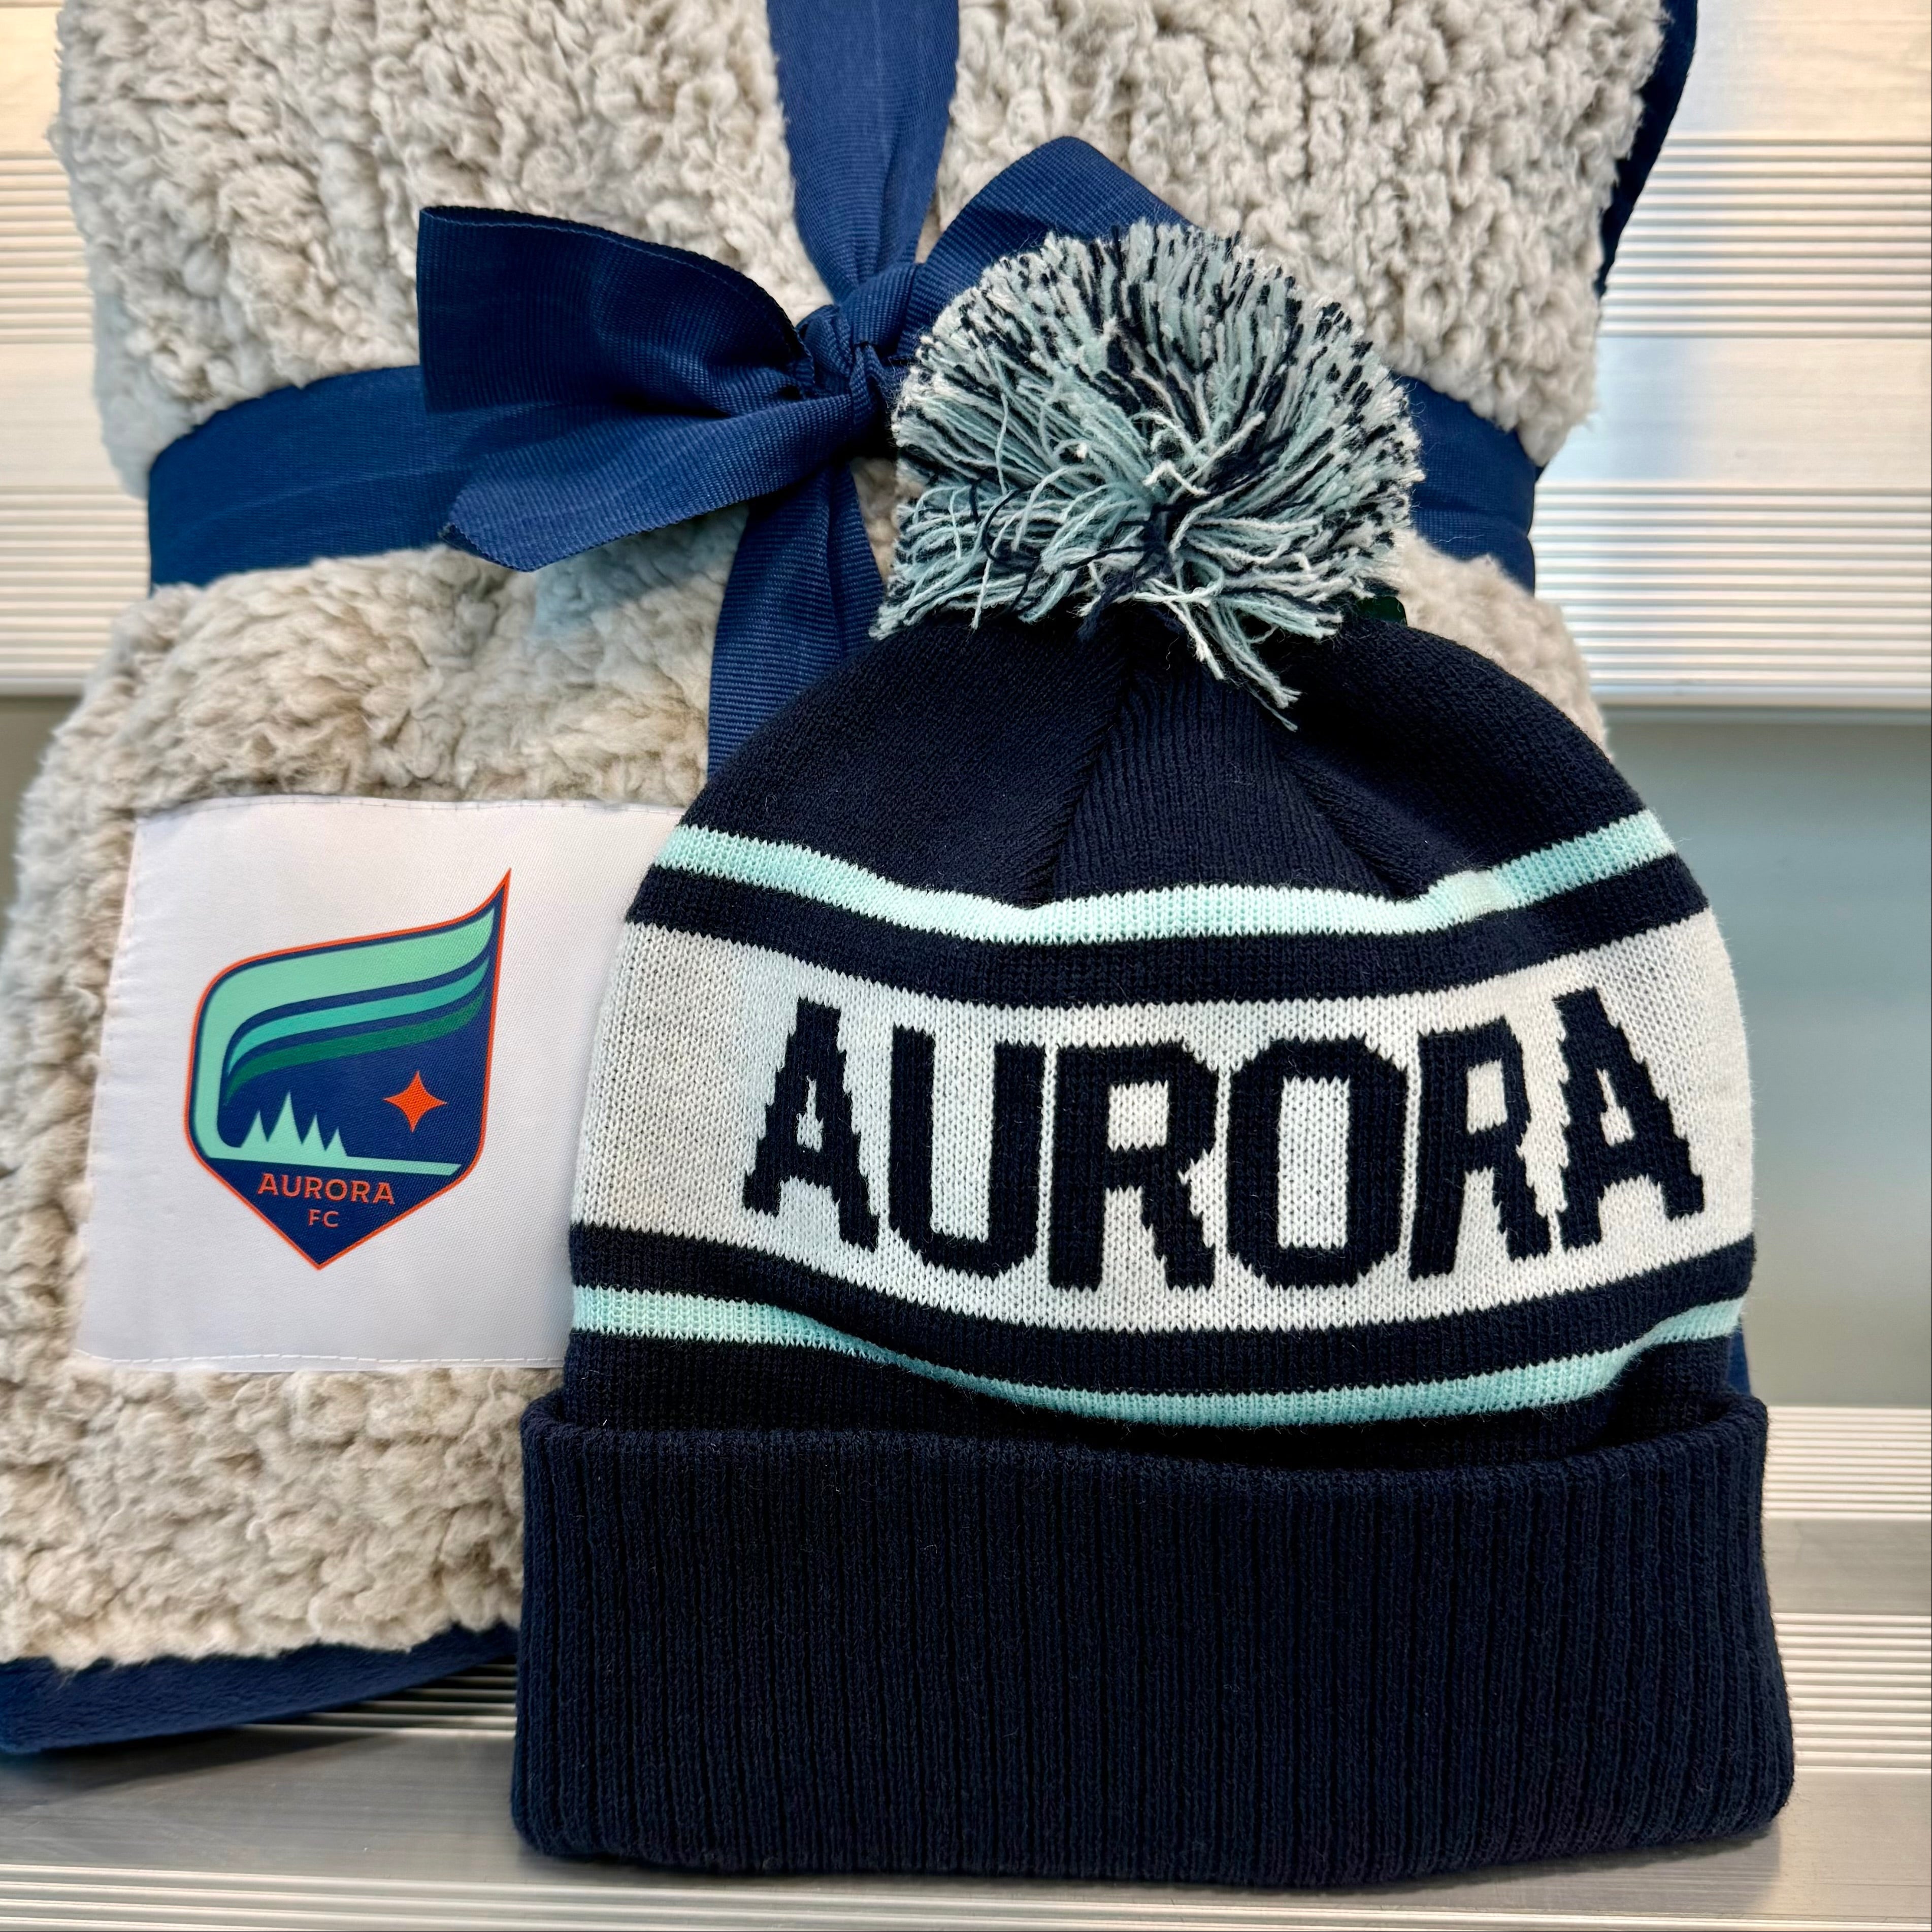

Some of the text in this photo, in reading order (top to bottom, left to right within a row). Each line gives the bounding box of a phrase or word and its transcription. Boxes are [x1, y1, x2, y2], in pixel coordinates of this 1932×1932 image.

[743, 988, 1705, 1291] AURORA
[258, 1173, 395, 1204] AURORA
[309, 1209, 339, 1227] FC
